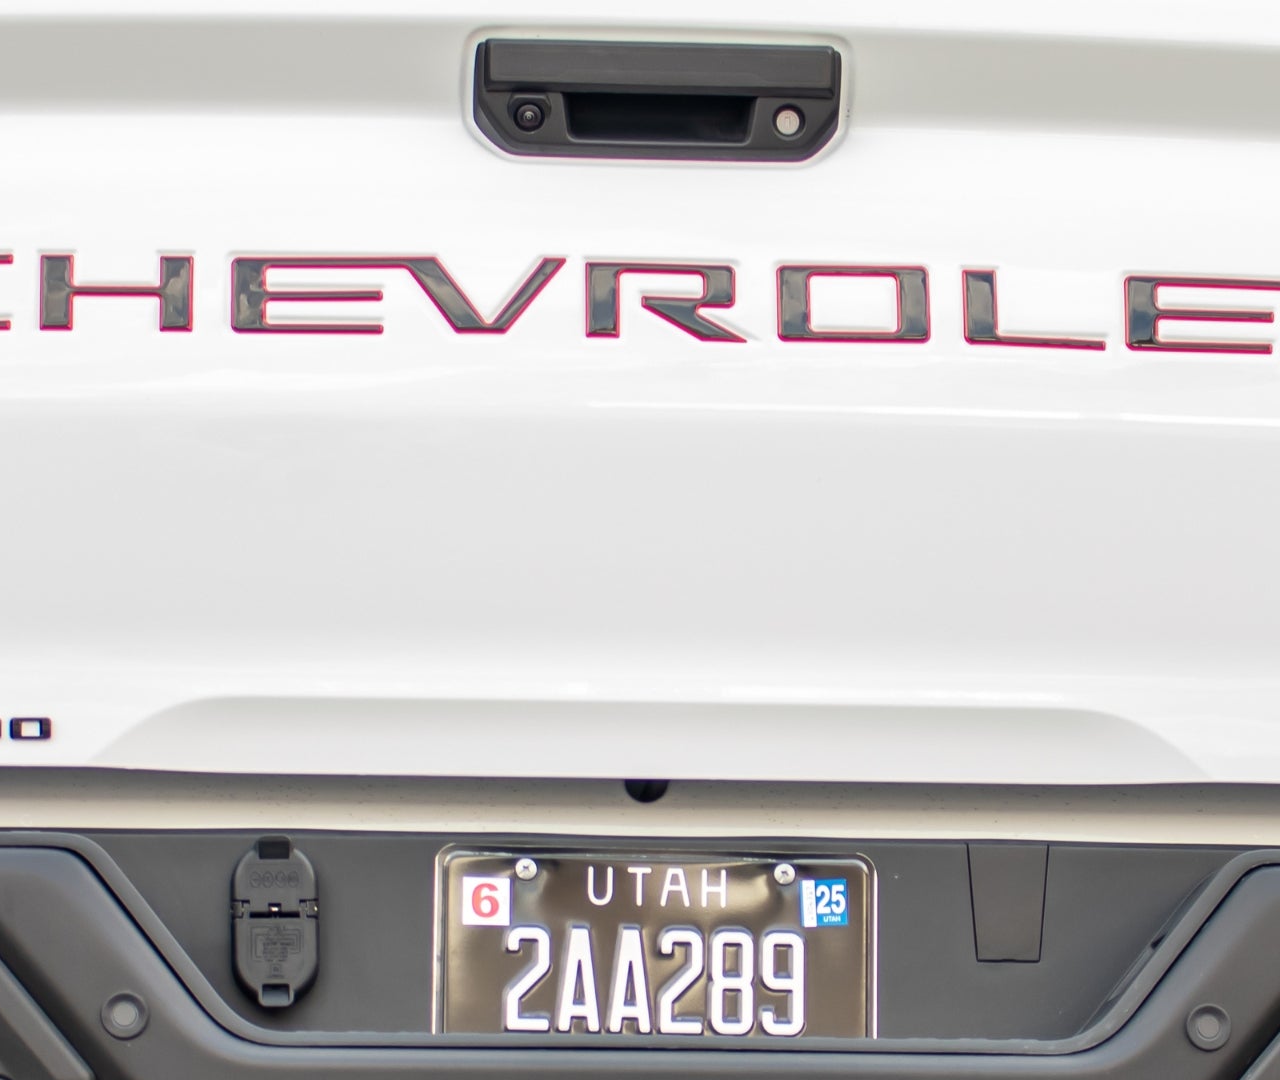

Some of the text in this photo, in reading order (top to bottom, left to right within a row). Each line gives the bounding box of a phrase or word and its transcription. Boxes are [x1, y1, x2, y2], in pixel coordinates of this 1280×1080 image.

[471, 883, 499, 918] 6
[587, 865, 727, 909] UTAH
[816, 885, 846, 914] 25
[823, 915, 841, 923] UTAH
[504, 924, 806, 1036] 2AA289
